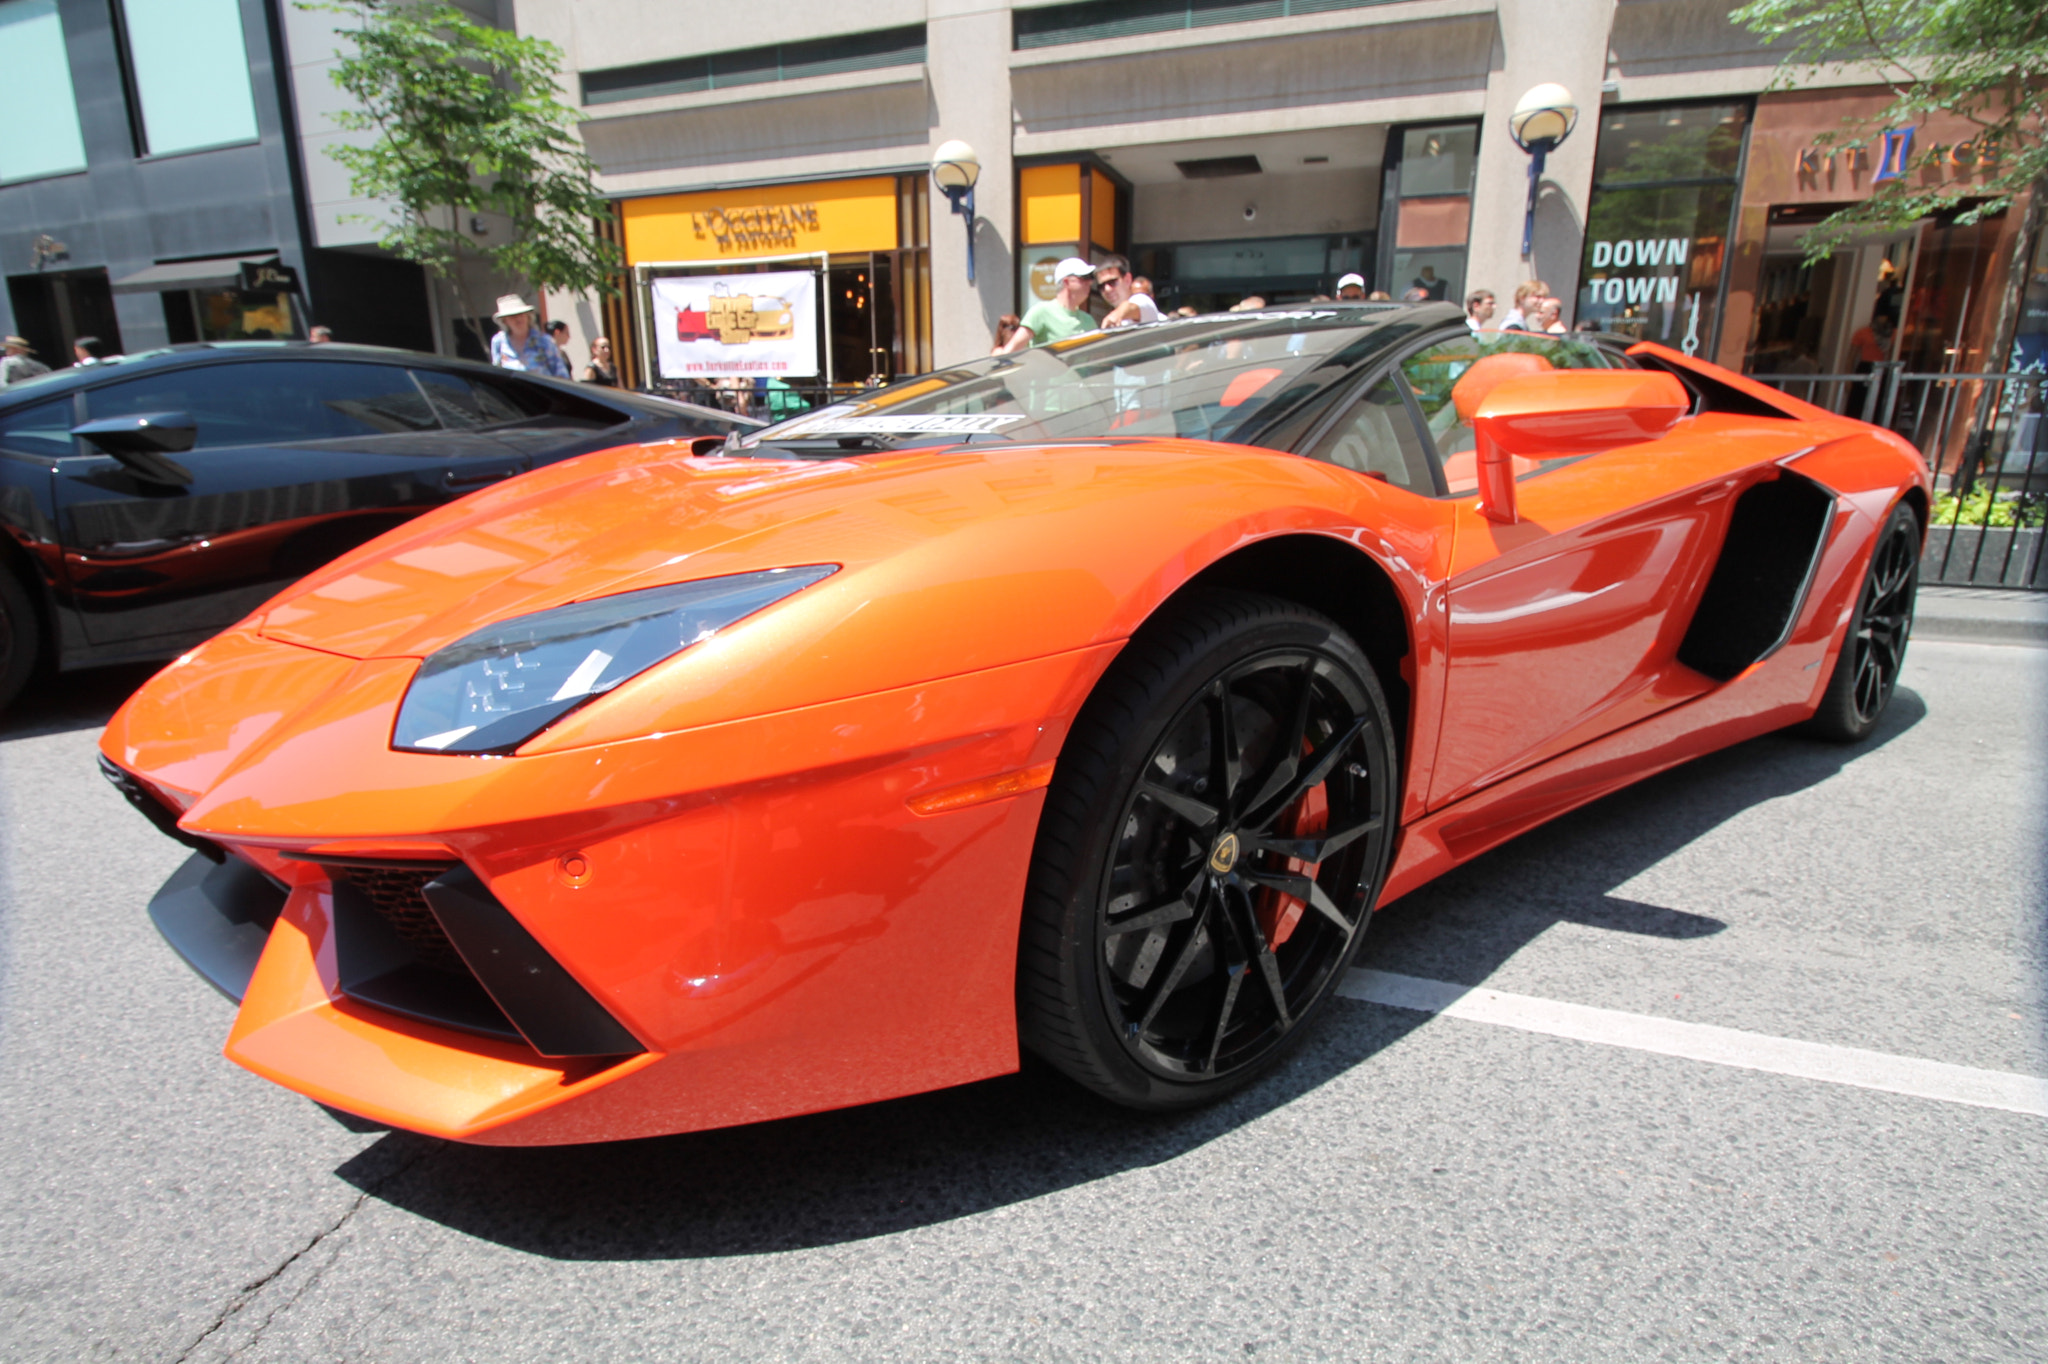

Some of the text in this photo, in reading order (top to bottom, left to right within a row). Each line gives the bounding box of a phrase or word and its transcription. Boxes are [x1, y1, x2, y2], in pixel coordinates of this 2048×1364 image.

[1795, 144, 1868, 173] KIT
[1592, 238, 1689, 268] DOWN
[1589, 276, 1679, 304] TOWN
